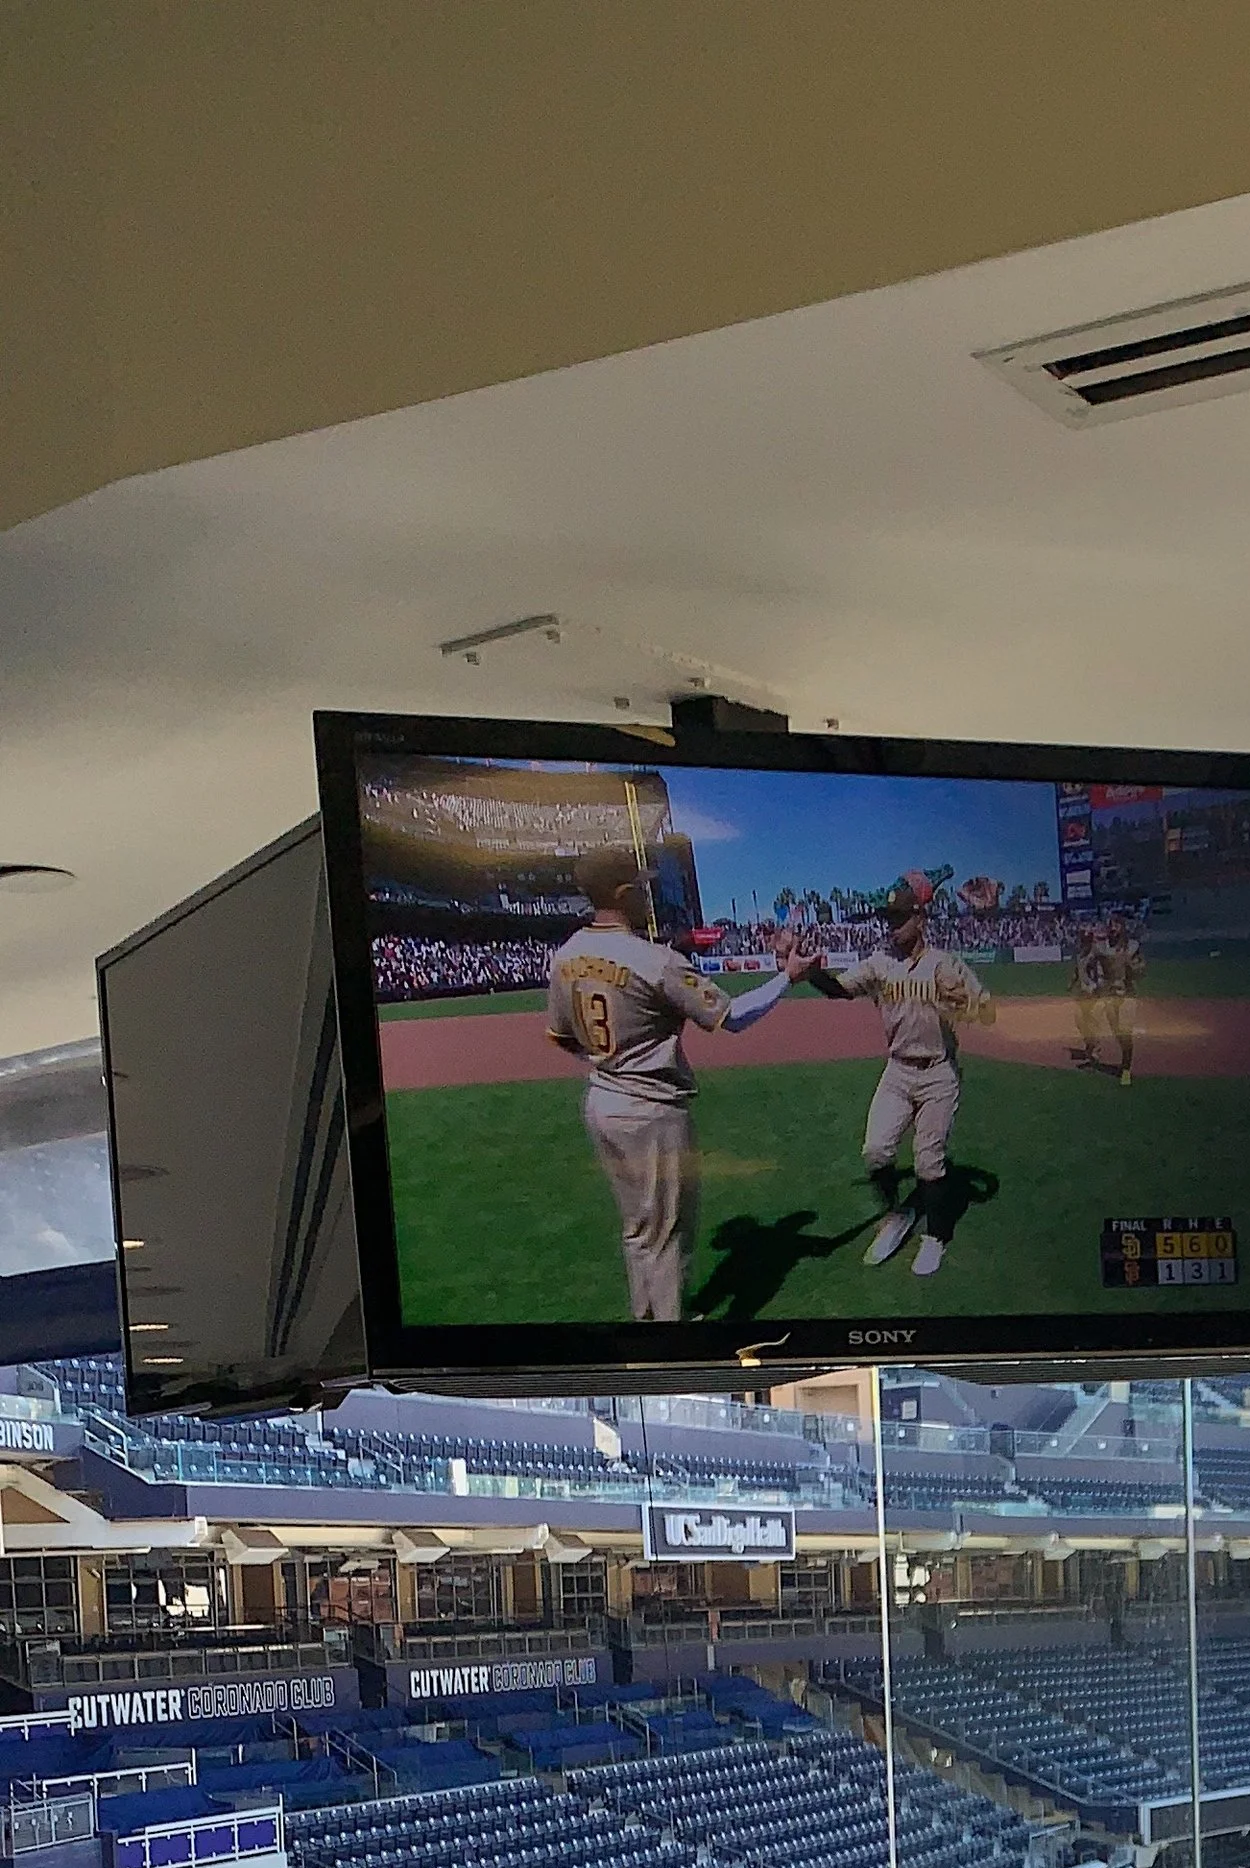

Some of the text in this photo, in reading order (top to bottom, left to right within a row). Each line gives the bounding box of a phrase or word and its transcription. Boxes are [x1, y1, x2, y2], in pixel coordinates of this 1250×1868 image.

[1112, 1217, 1224, 1232] FINAL R H E
[1162, 1234, 1176, 1255] 5
[1189, 1233, 1201, 1253] 6
[1214, 1234, 1227, 1254] 0
[1165, 1263, 1176, 1281] 1
[1191, 1262, 1203, 1280] 3
[1217, 1262, 1226, 1280] 1
[848, 1330, 917, 1345] SONY
[492, 1659, 563, 1692] CORONADO
[564, 1657, 596, 1686] CLUB
[187, 1680, 288, 1720] CORONADO
[290, 1676, 336, 1711] CLUB
